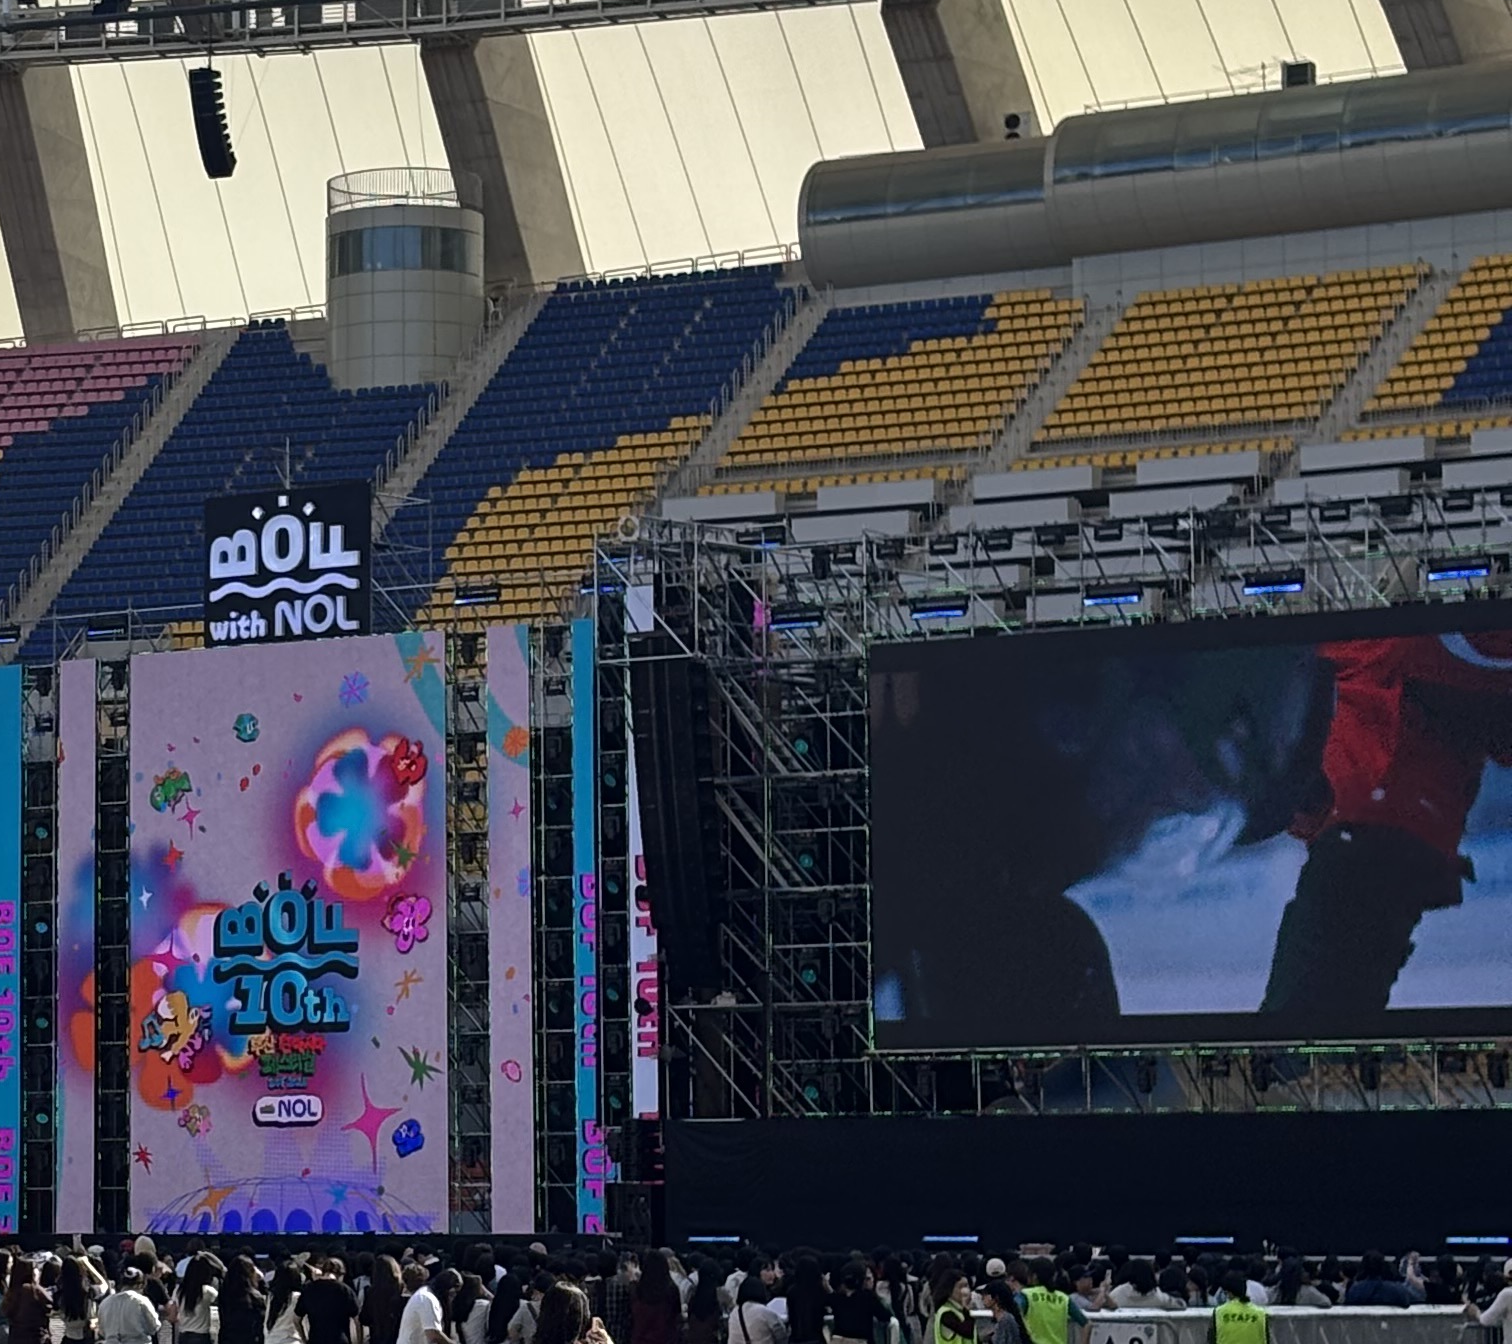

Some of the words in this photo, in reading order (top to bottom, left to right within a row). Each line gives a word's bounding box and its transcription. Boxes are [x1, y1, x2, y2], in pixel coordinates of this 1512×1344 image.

[209, 611, 268, 641] with
[274, 593, 360, 636] NOL
[217, 889, 360, 954] BOF
[234, 969, 352, 1030] 10th
[278, 1098, 318, 1118] NOL
